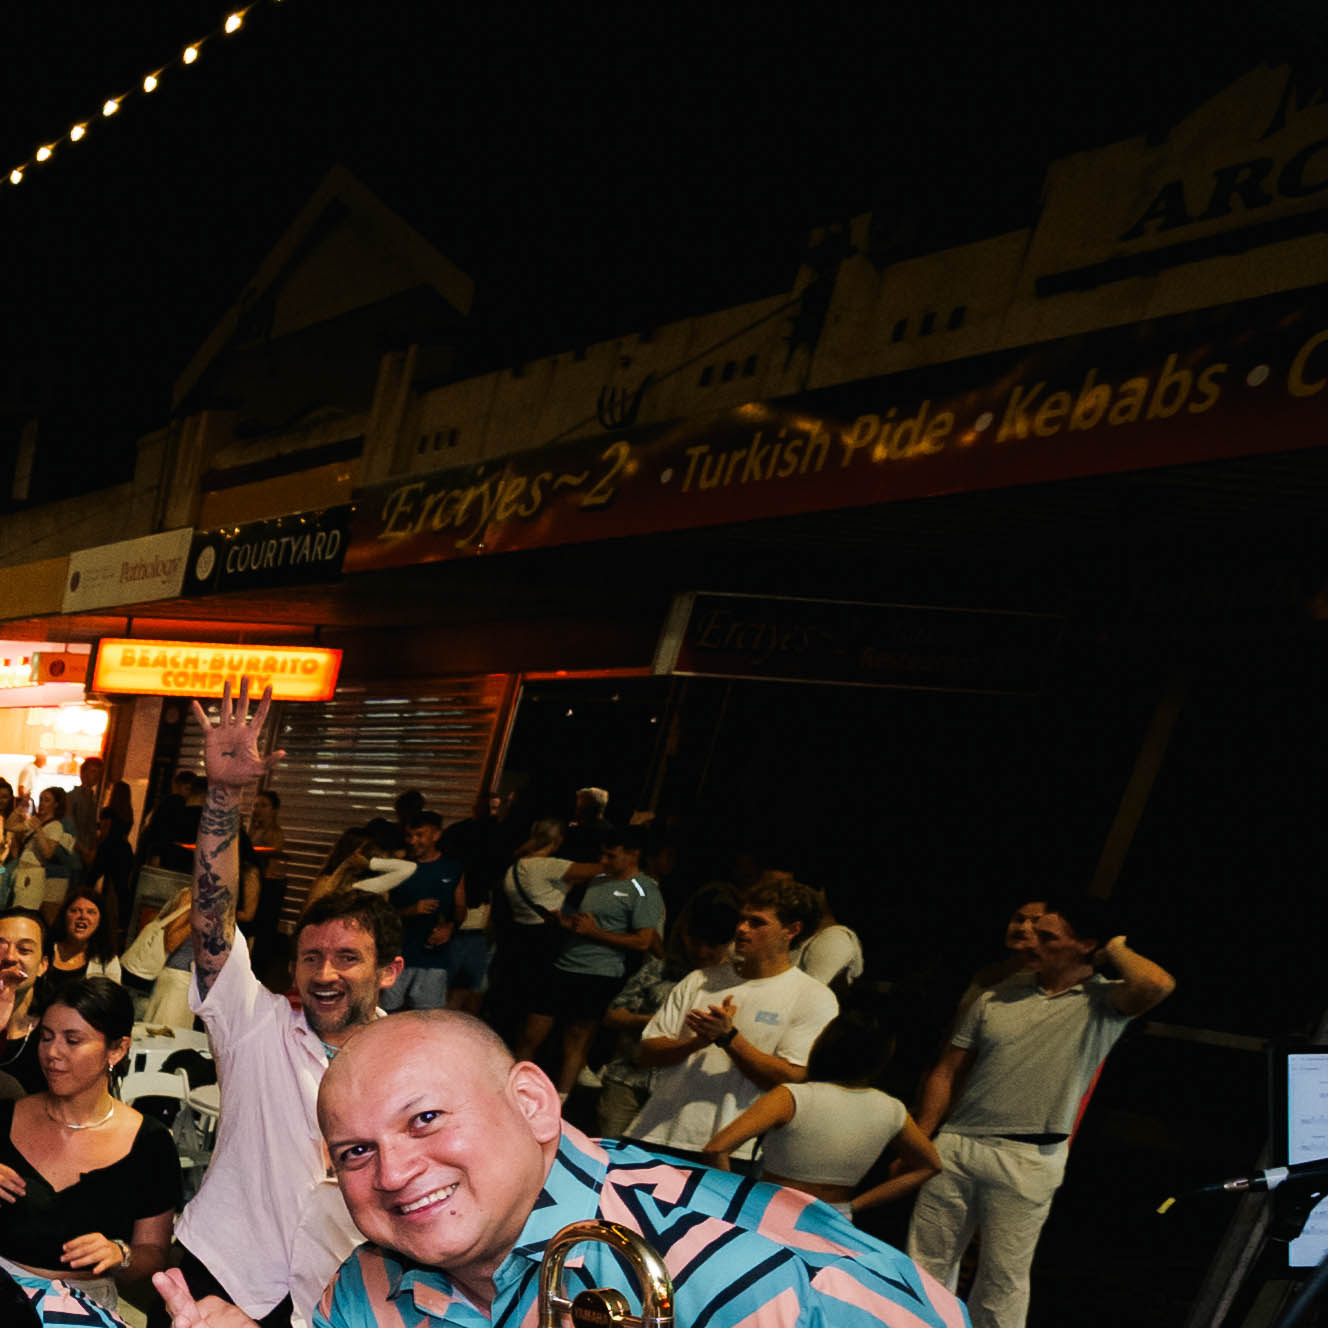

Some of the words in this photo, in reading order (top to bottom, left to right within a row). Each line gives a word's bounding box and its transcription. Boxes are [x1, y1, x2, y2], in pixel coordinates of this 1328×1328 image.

[681, 424, 831, 493] Turkish
[842, 401, 956, 468] Pide
[996, 354, 1228, 443] Kebabs
[225, 529, 342, 576] COURTYARD
[119, 648, 200, 670] BEACH
[208, 648, 320, 676] BURRITO
